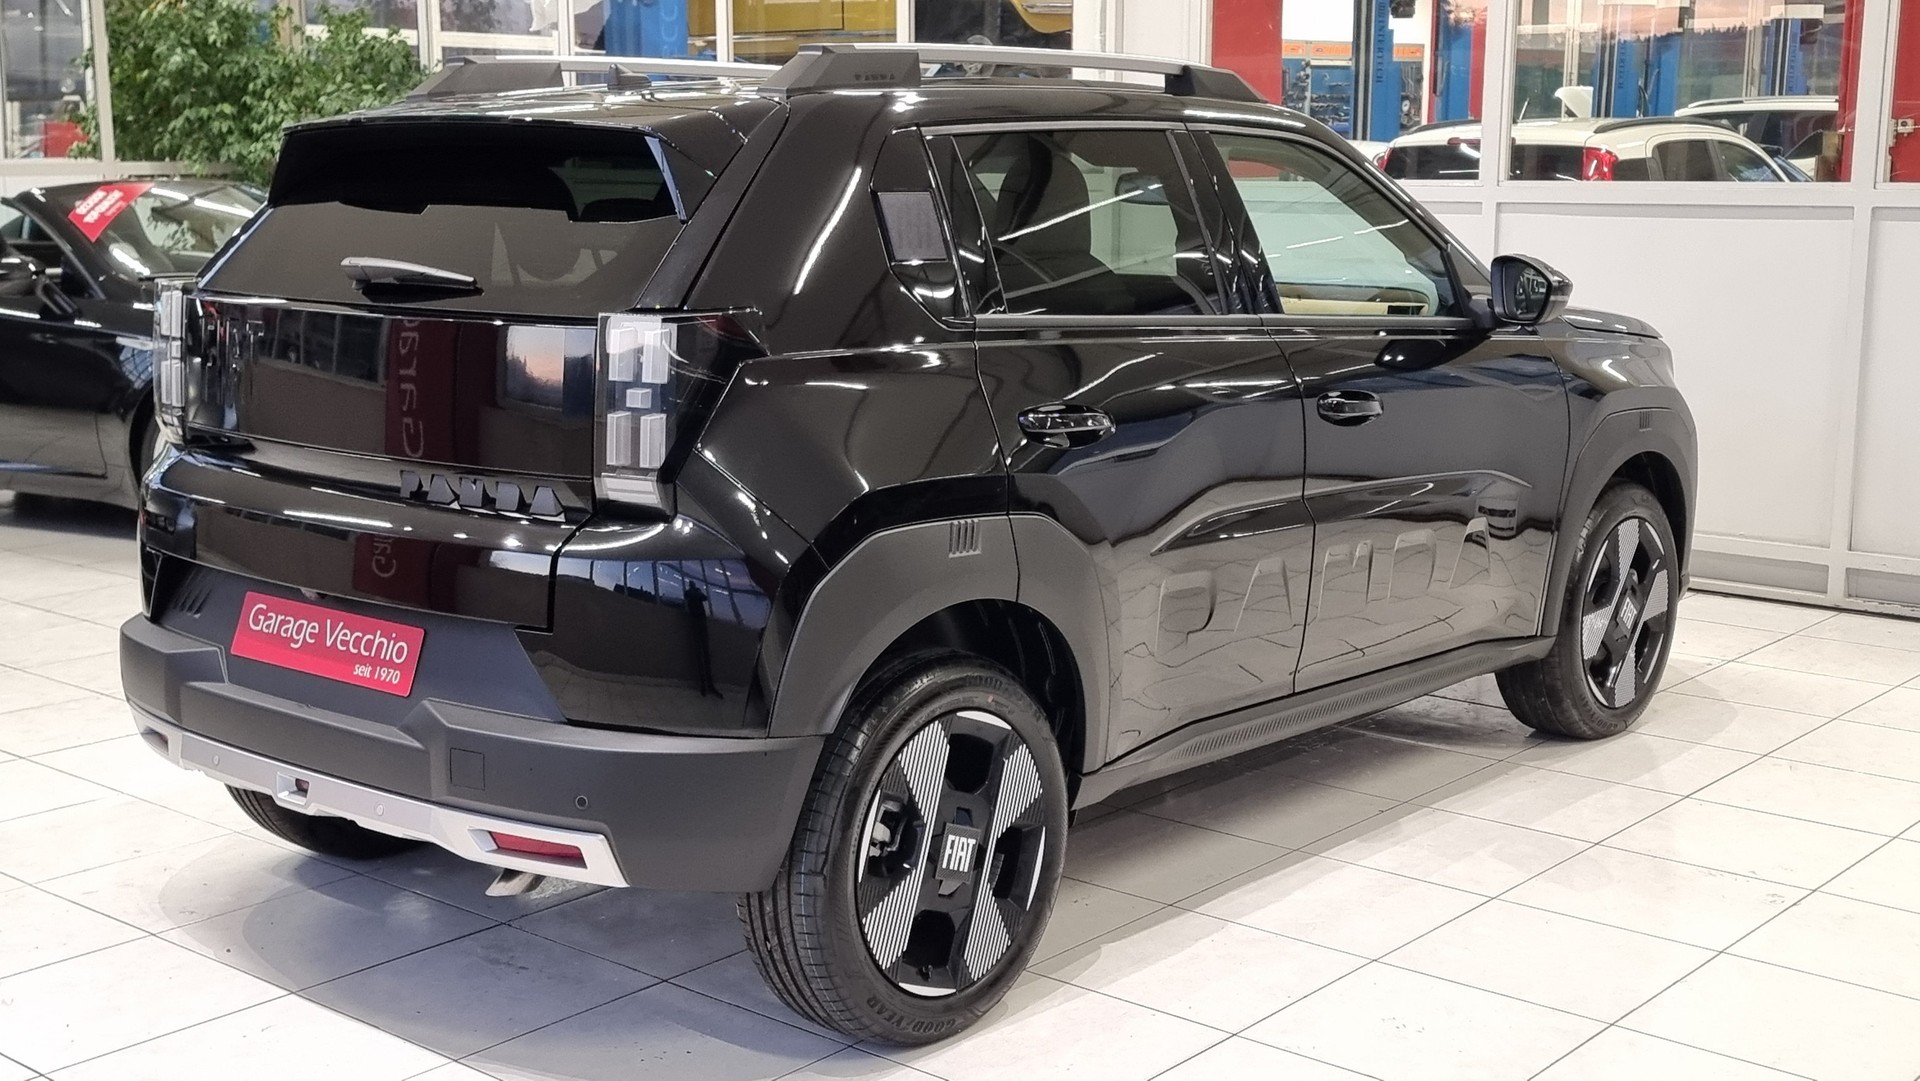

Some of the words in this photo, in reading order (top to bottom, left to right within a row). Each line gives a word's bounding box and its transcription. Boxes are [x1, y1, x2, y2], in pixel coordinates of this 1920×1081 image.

[400, 469, 568, 522] PANDA
[248, 603, 319, 649] Garage
[325, 618, 408, 664] Vecchio
[353, 663, 372, 679] seit
[374, 666, 401, 685] 1970
[941, 834, 977, 873] FIAT
